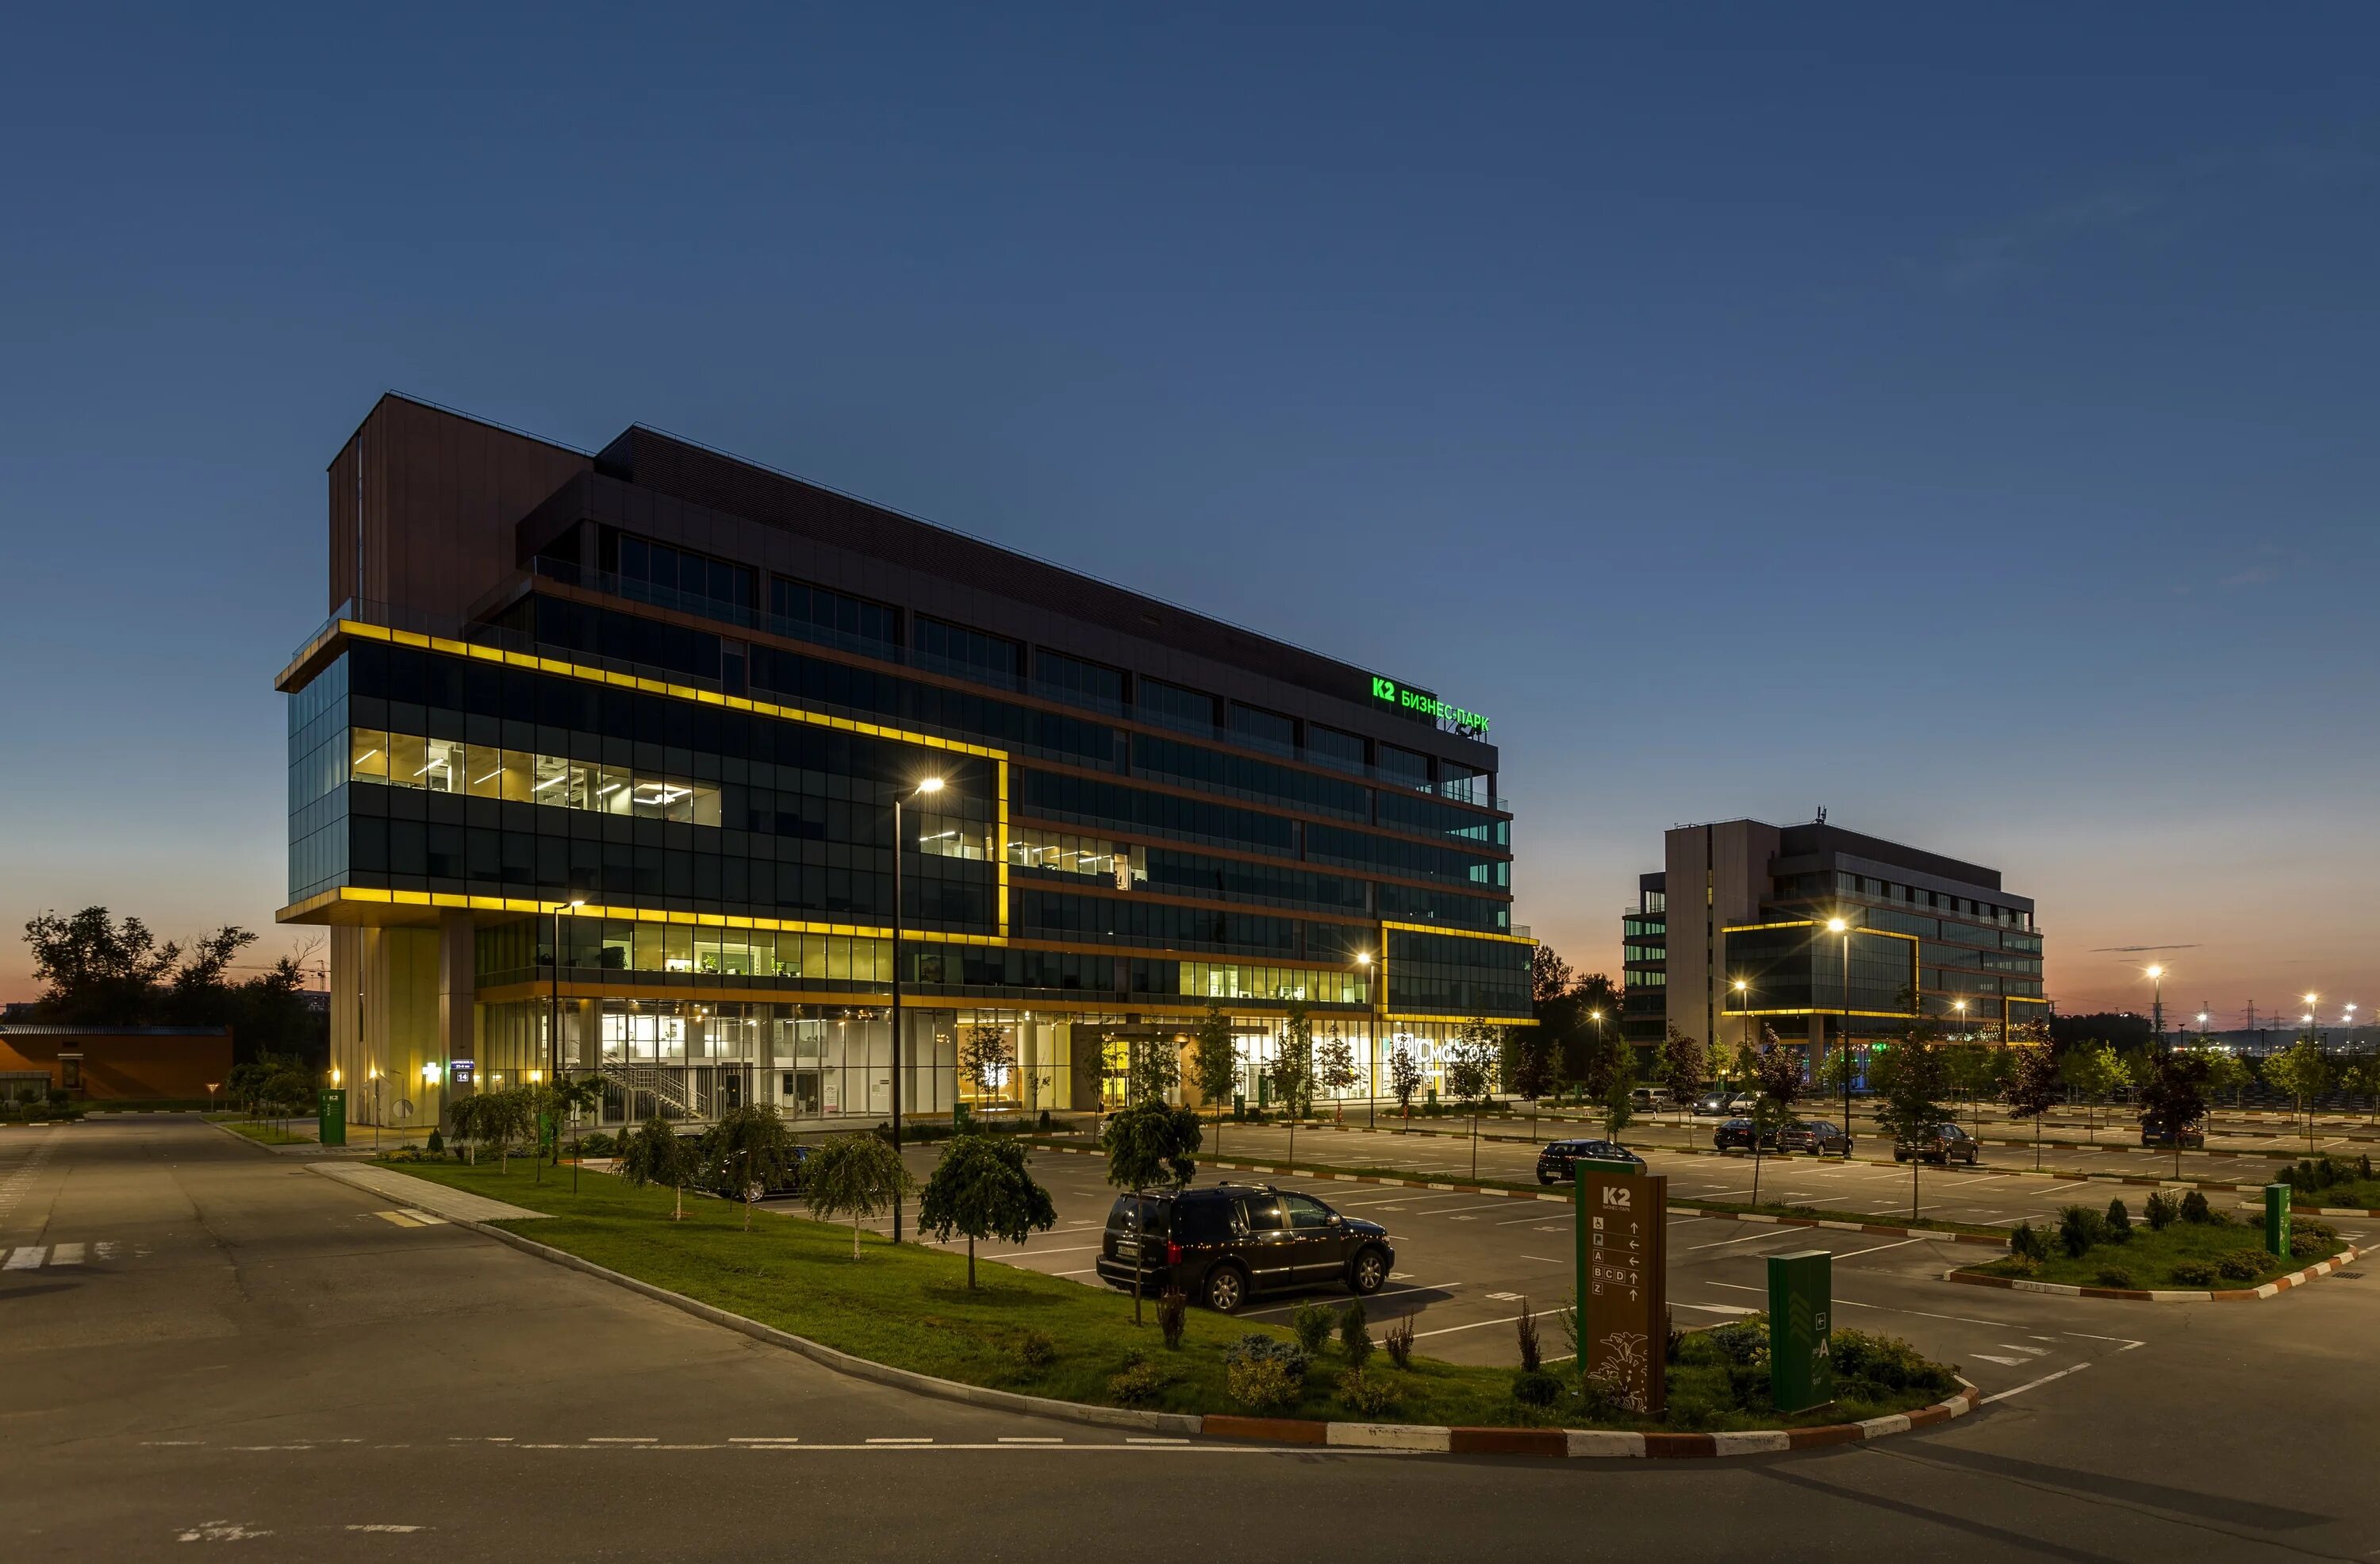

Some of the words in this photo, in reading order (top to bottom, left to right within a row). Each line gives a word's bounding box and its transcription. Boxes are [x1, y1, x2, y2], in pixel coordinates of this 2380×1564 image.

[1402, 690, 1489, 732] БИЗНЕС-ПАРК
[1603, 1186, 1630, 1206] K2
[1595, 1251, 1602, 1260] A
[1595, 1267, 1601, 1277] B
[1606, 1270, 1613, 1278] C
[1616, 1271, 1623, 1280] D
[1595, 1284, 1601, 1293] Z
[1819, 1339, 1829, 1358] A
